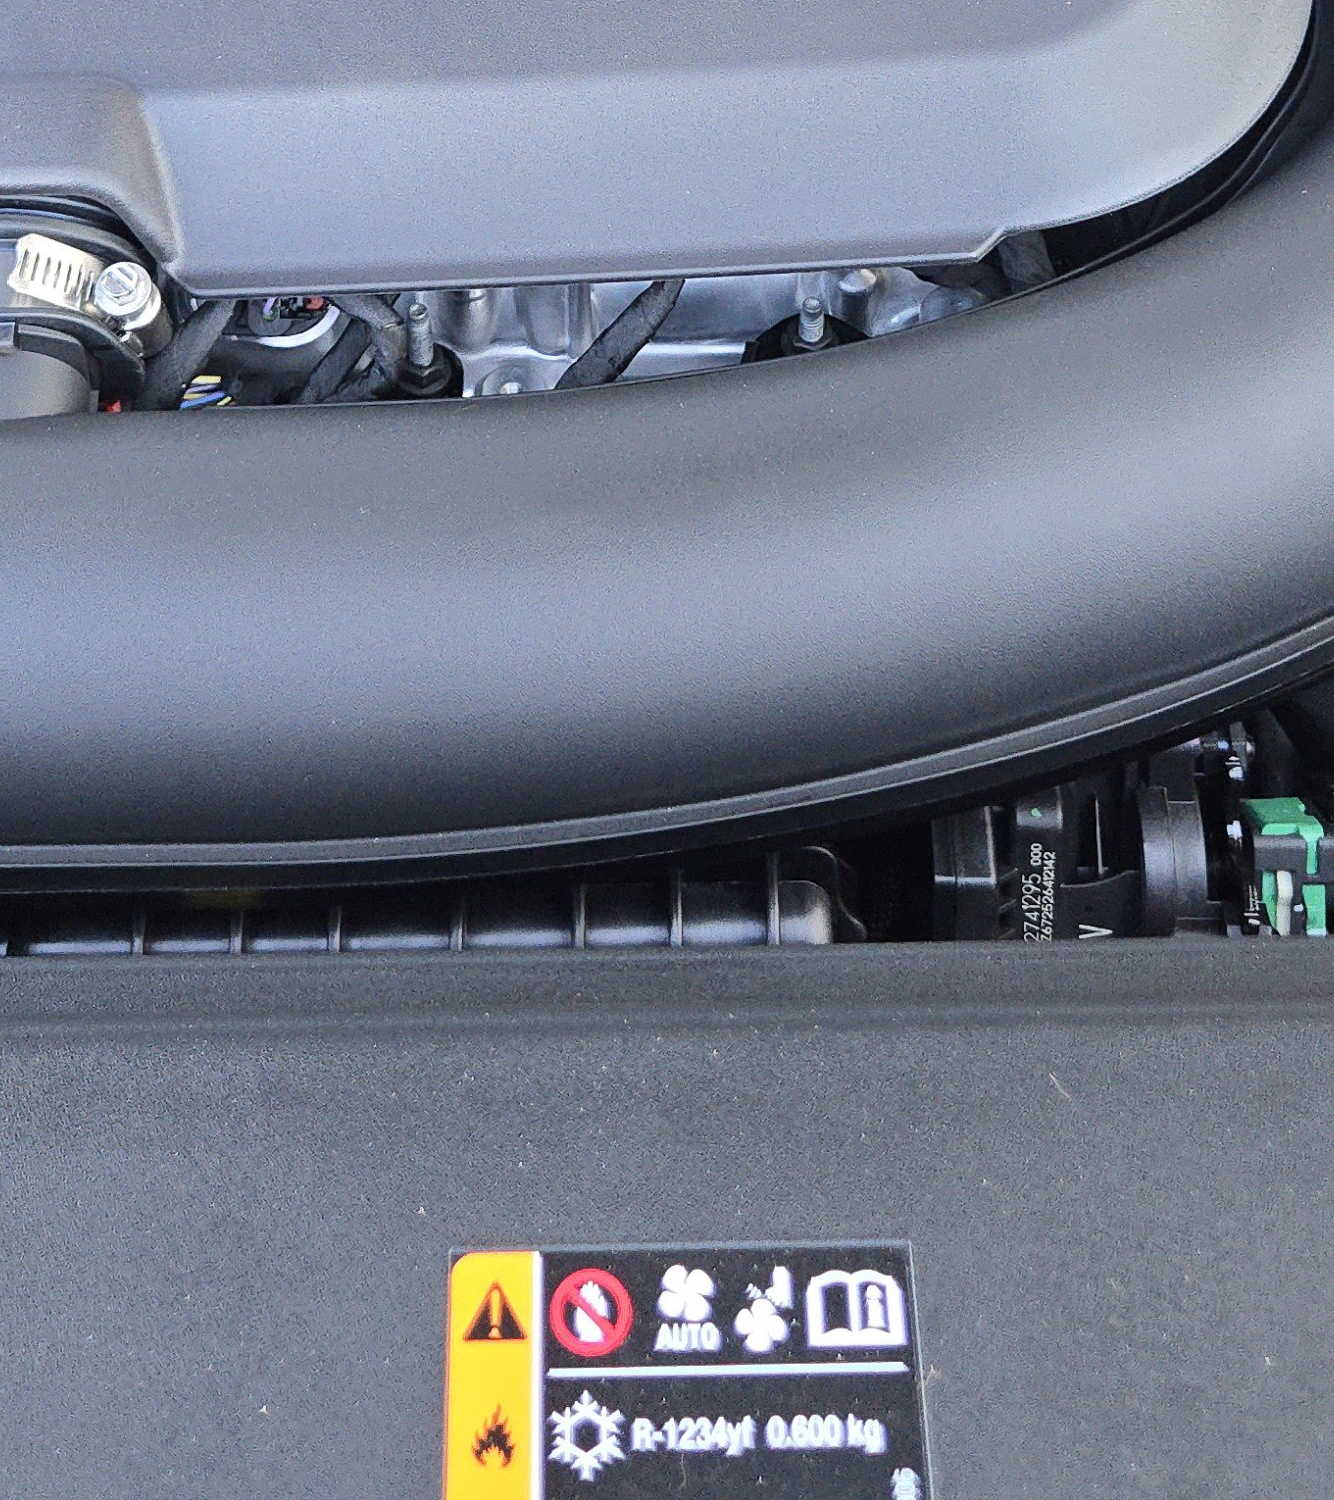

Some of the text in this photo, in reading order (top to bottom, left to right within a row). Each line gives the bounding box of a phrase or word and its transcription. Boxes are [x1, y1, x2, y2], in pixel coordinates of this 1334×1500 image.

[1022, 842, 1042, 943] 2741295 000
[654, 1322, 723, 1352] AUTO
[631, 1413, 887, 1455] R-1234yf 0.600 kg
